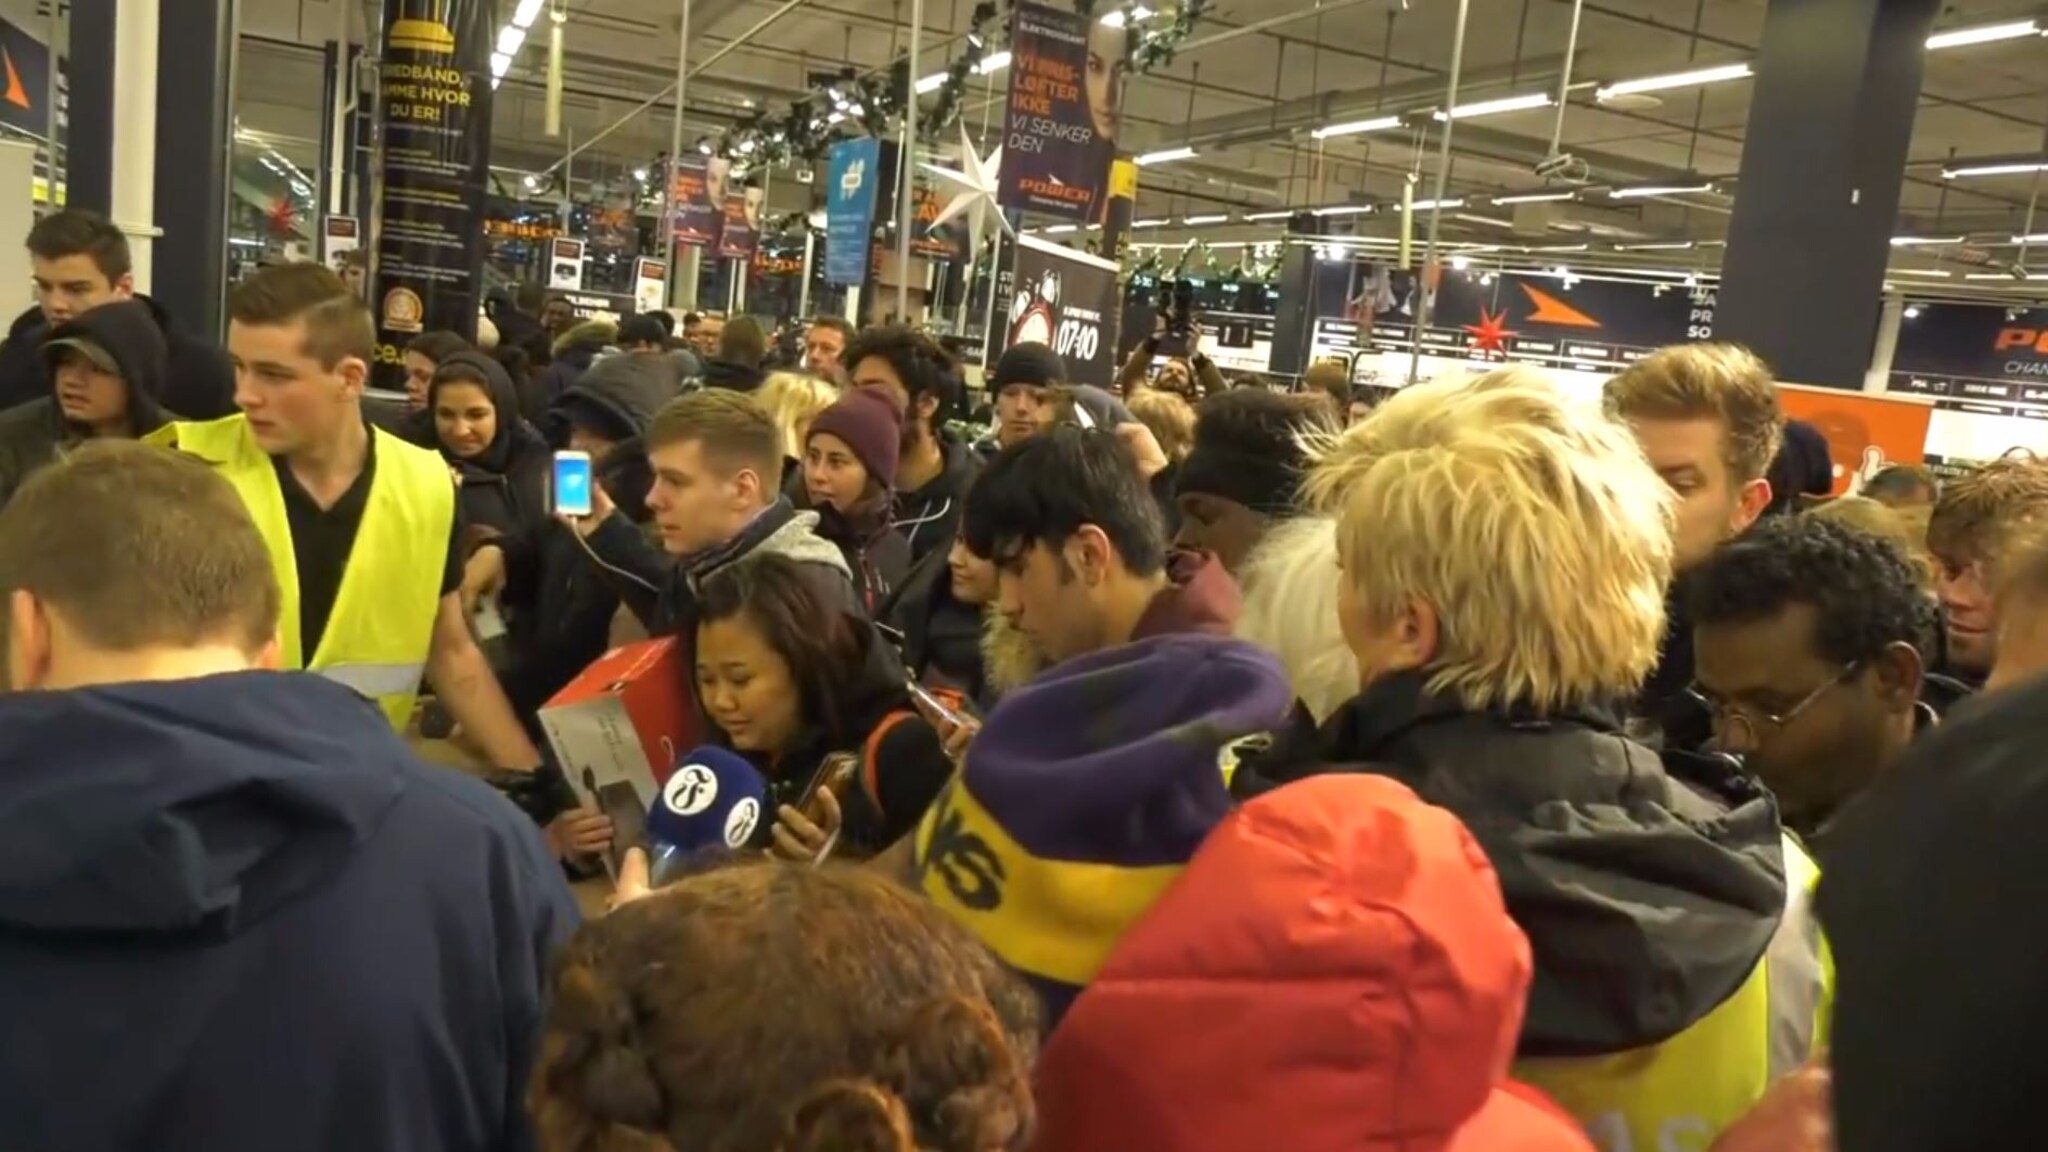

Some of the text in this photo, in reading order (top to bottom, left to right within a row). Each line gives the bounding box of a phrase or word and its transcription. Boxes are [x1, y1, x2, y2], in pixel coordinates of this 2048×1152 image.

[420, 86, 471, 107] HVOR
[1012, 92, 1051, 115] IKKE
[390, 103, 440, 122] DU ER!
[1012, 113, 1092, 144] VI SENKER
[1008, 132, 1044, 154] DEN
[1019, 179, 1091, 203] POWER
[1690, 309, 1713, 322] PR
[1687, 325, 1712, 339] SO
